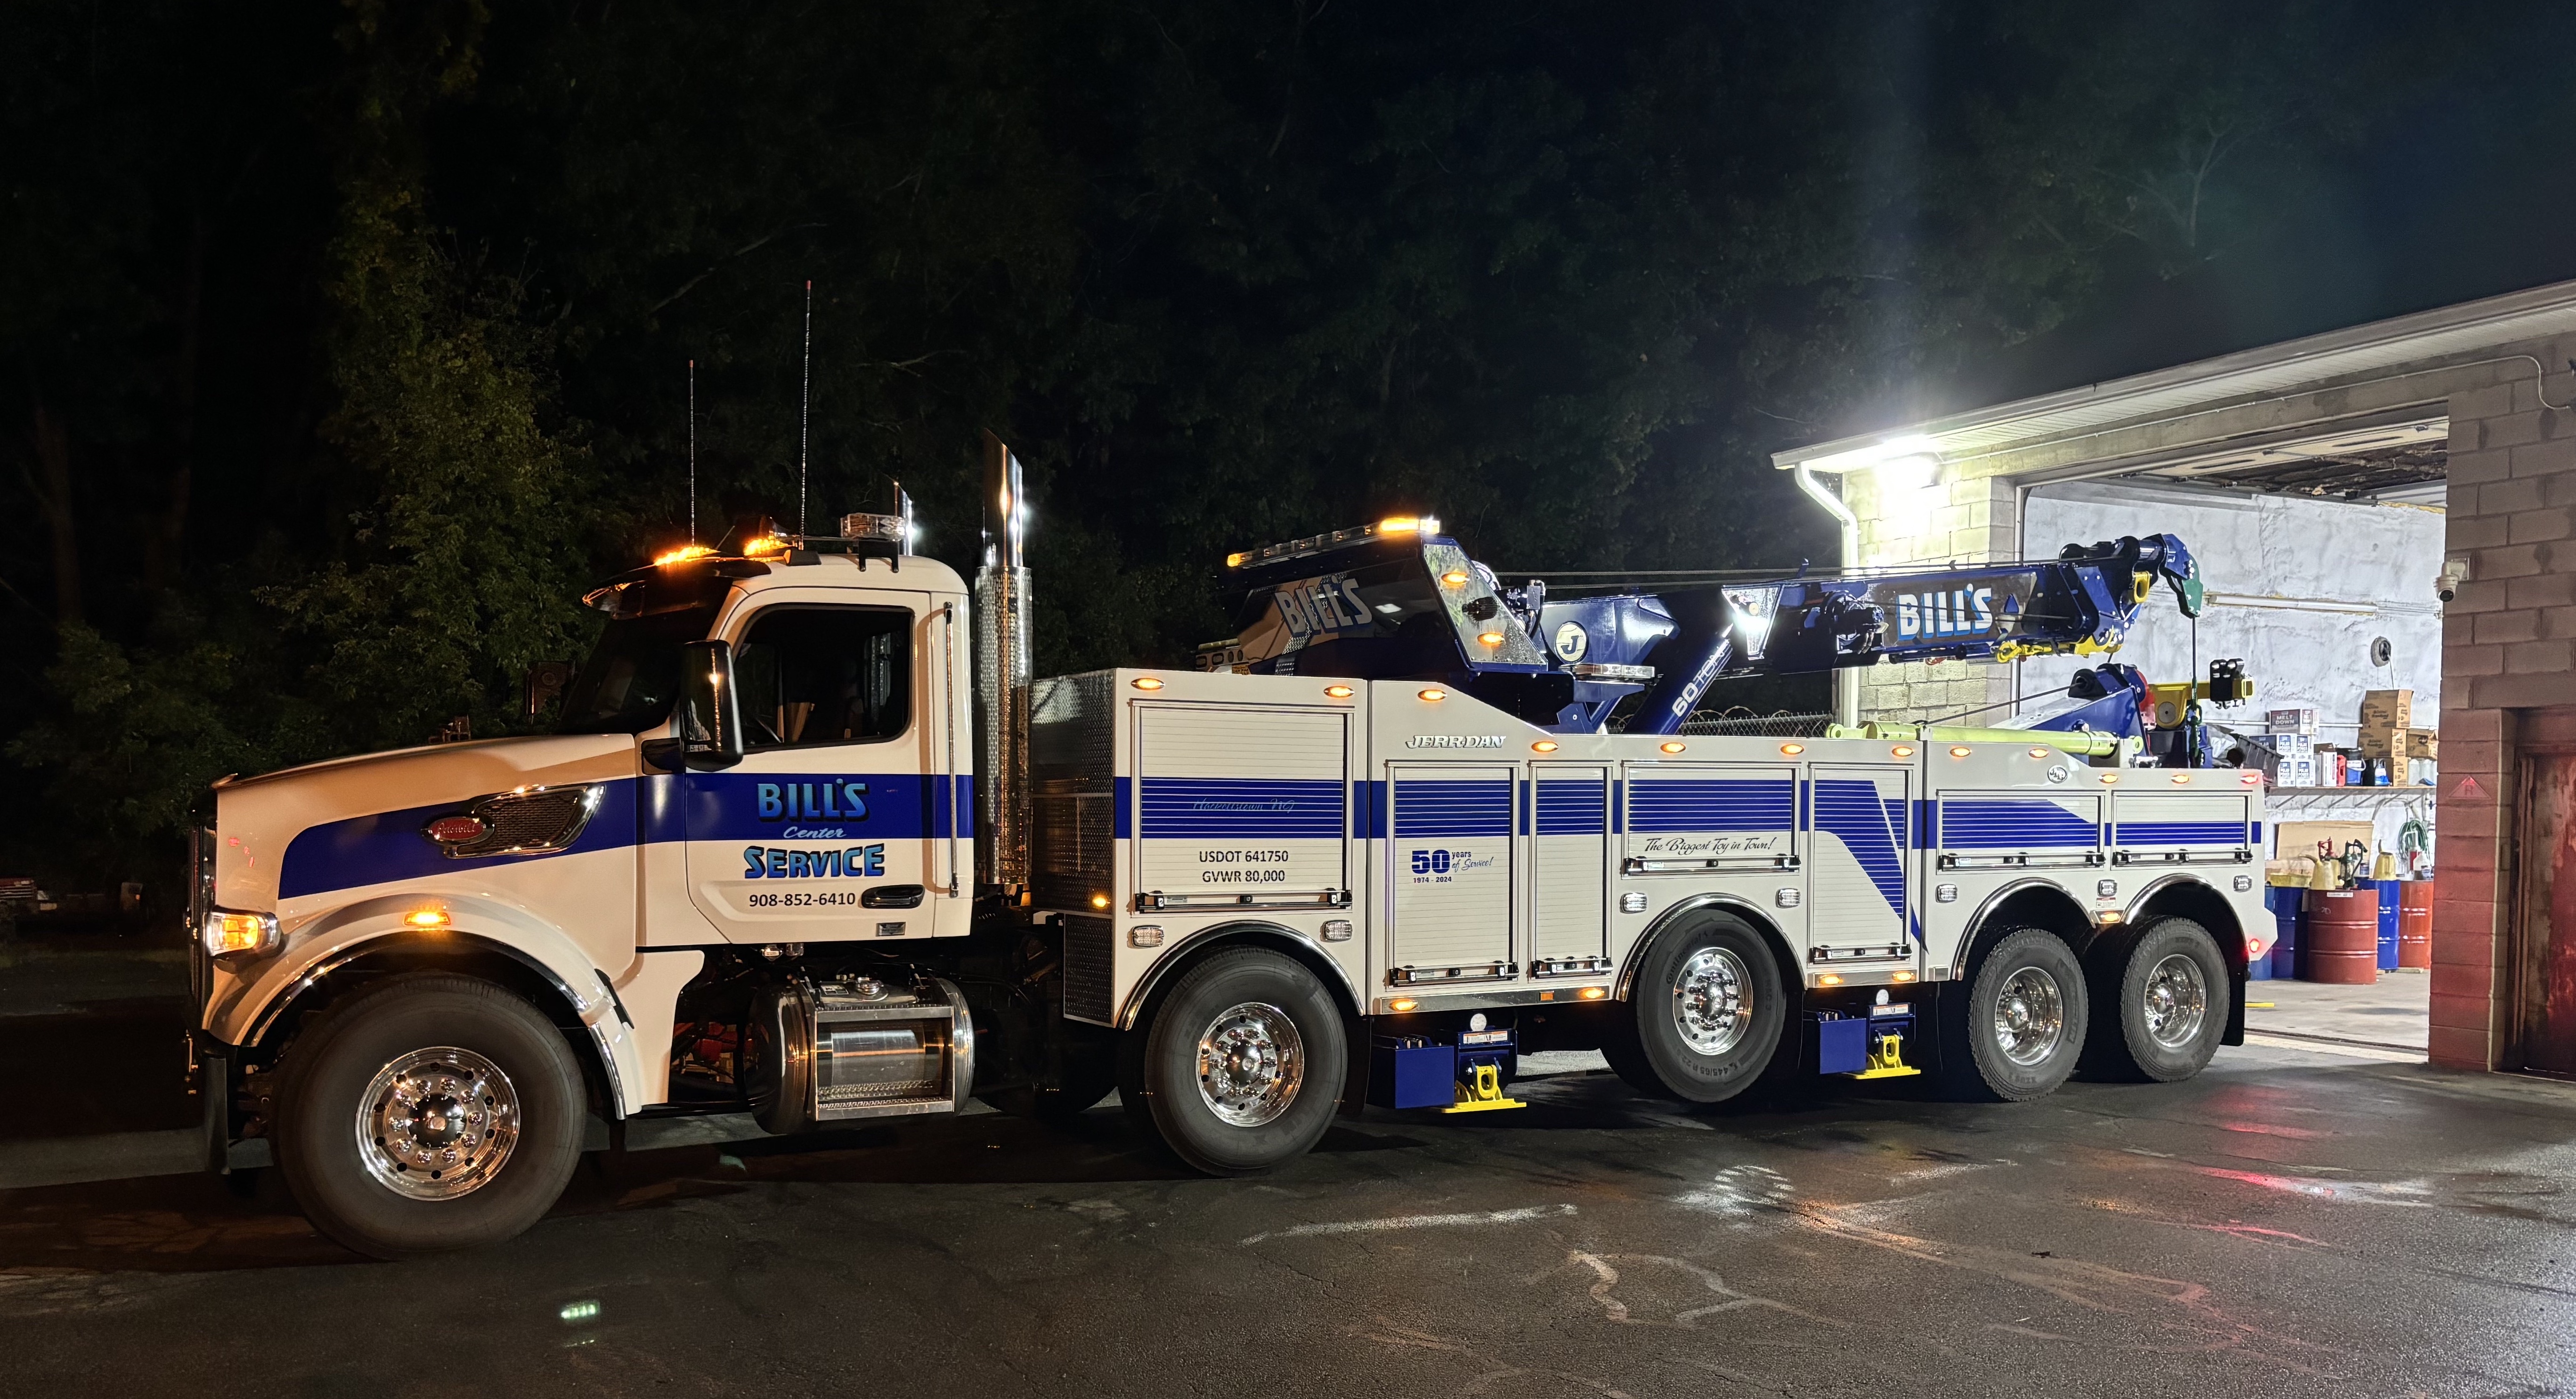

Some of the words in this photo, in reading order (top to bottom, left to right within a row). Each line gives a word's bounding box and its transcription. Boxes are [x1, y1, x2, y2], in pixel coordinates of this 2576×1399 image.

[1275, 575, 1372, 636] BILL'S
[1896, 583, 1992, 640] BILL'S
[1561, 635, 1579, 654] J
[1672, 682, 1698, 717] 60
[757, 778, 870, 822] BILL'S
[783, 826, 847, 839] Center
[1644, 837, 1663, 852] The
[1666, 837, 1712, 855] Biggest
[1712, 837, 1729, 855] Toy
[1731, 841, 1741, 850] in
[1744, 837, 1777, 851] Town!
[743, 843, 885, 879] SERVICE
[1199, 851, 1242, 863] USDOT
[1245, 850, 1289, 862] 641750
[1412, 849, 1450, 874] 50
[1452, 851, 1471, 860] years
[1452, 859, 1461, 872] of
[1461, 857, 1494, 871] Service!
[1202, 871, 1241, 882] GVWR
[1245, 870, 1285, 884] 80,000
[749, 893, 856, 907] 908-852-6410
